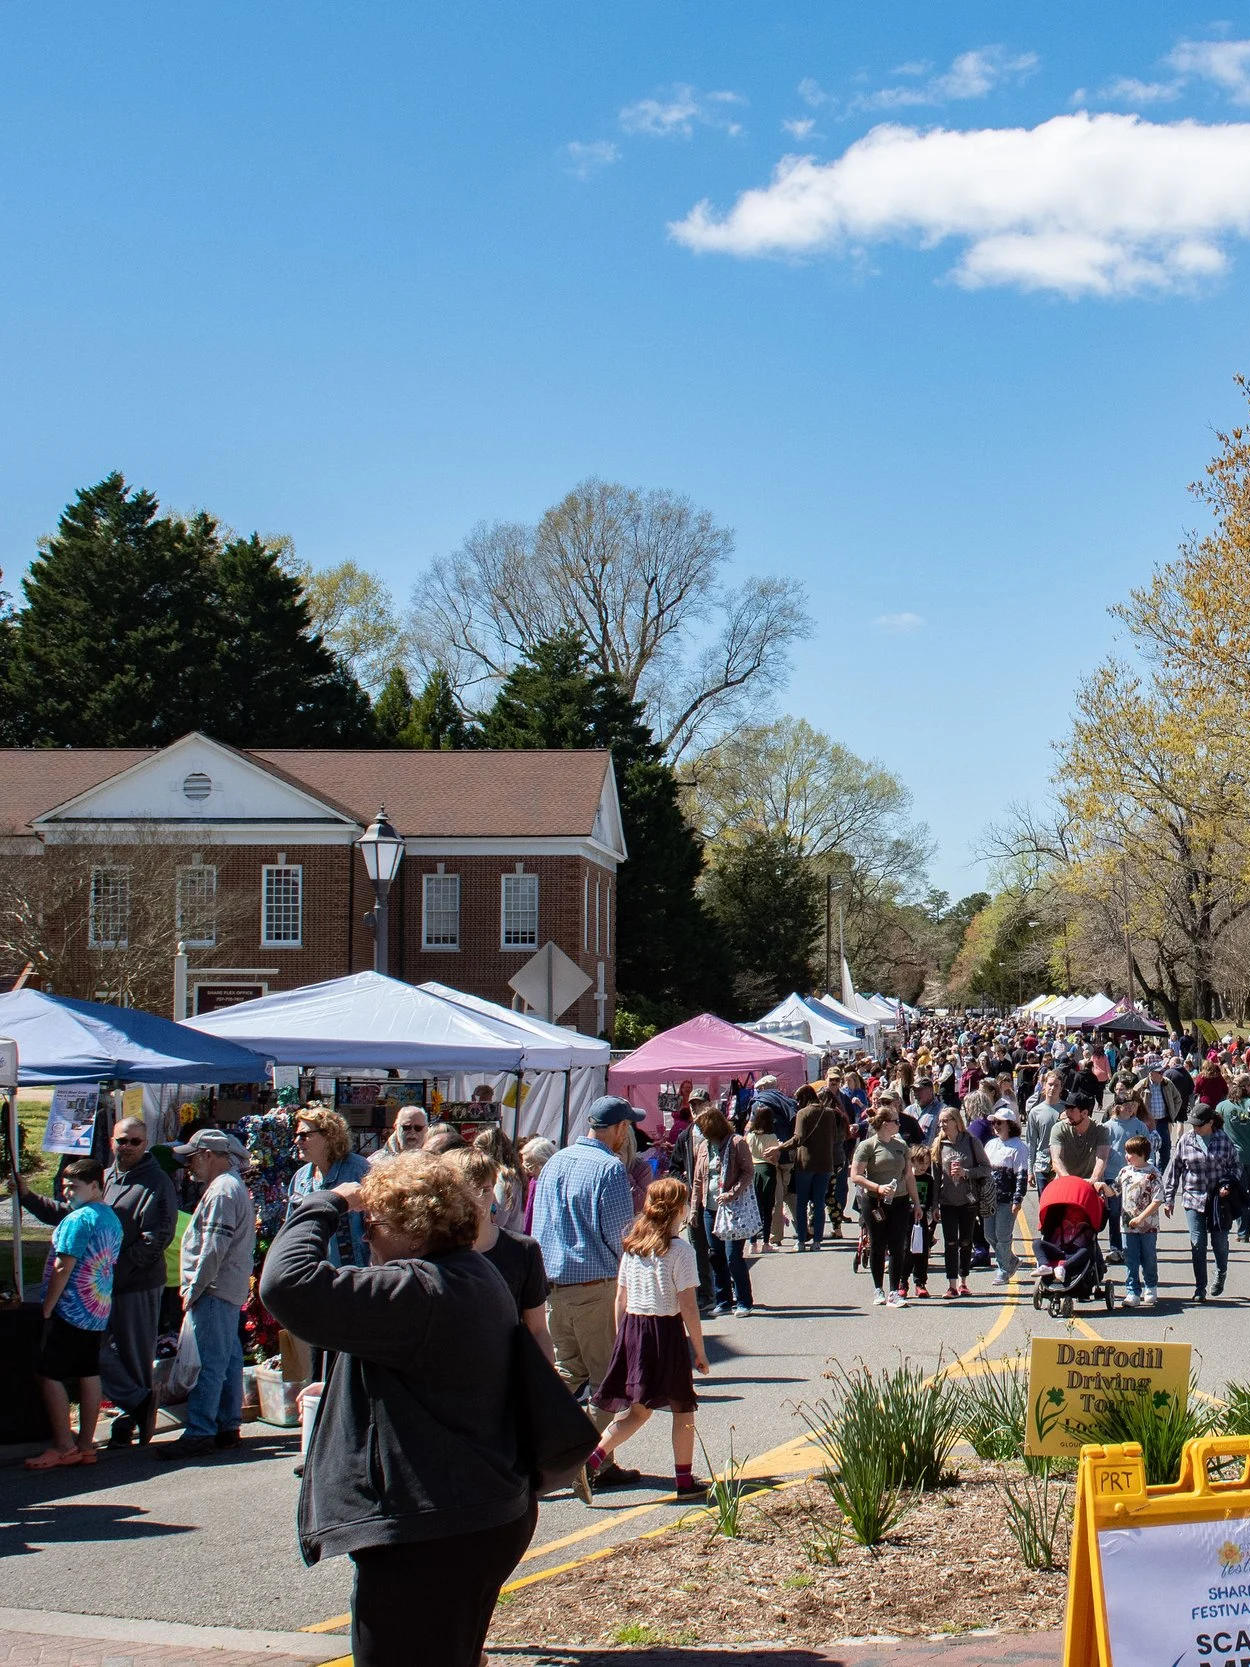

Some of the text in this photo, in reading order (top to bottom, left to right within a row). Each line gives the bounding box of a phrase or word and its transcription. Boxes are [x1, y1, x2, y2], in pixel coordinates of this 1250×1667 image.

[1056, 1343, 1163, 1369] Daffodil
[1066, 1370, 1152, 1397] Driving
[1101, 1471, 1133, 1492] PRT
